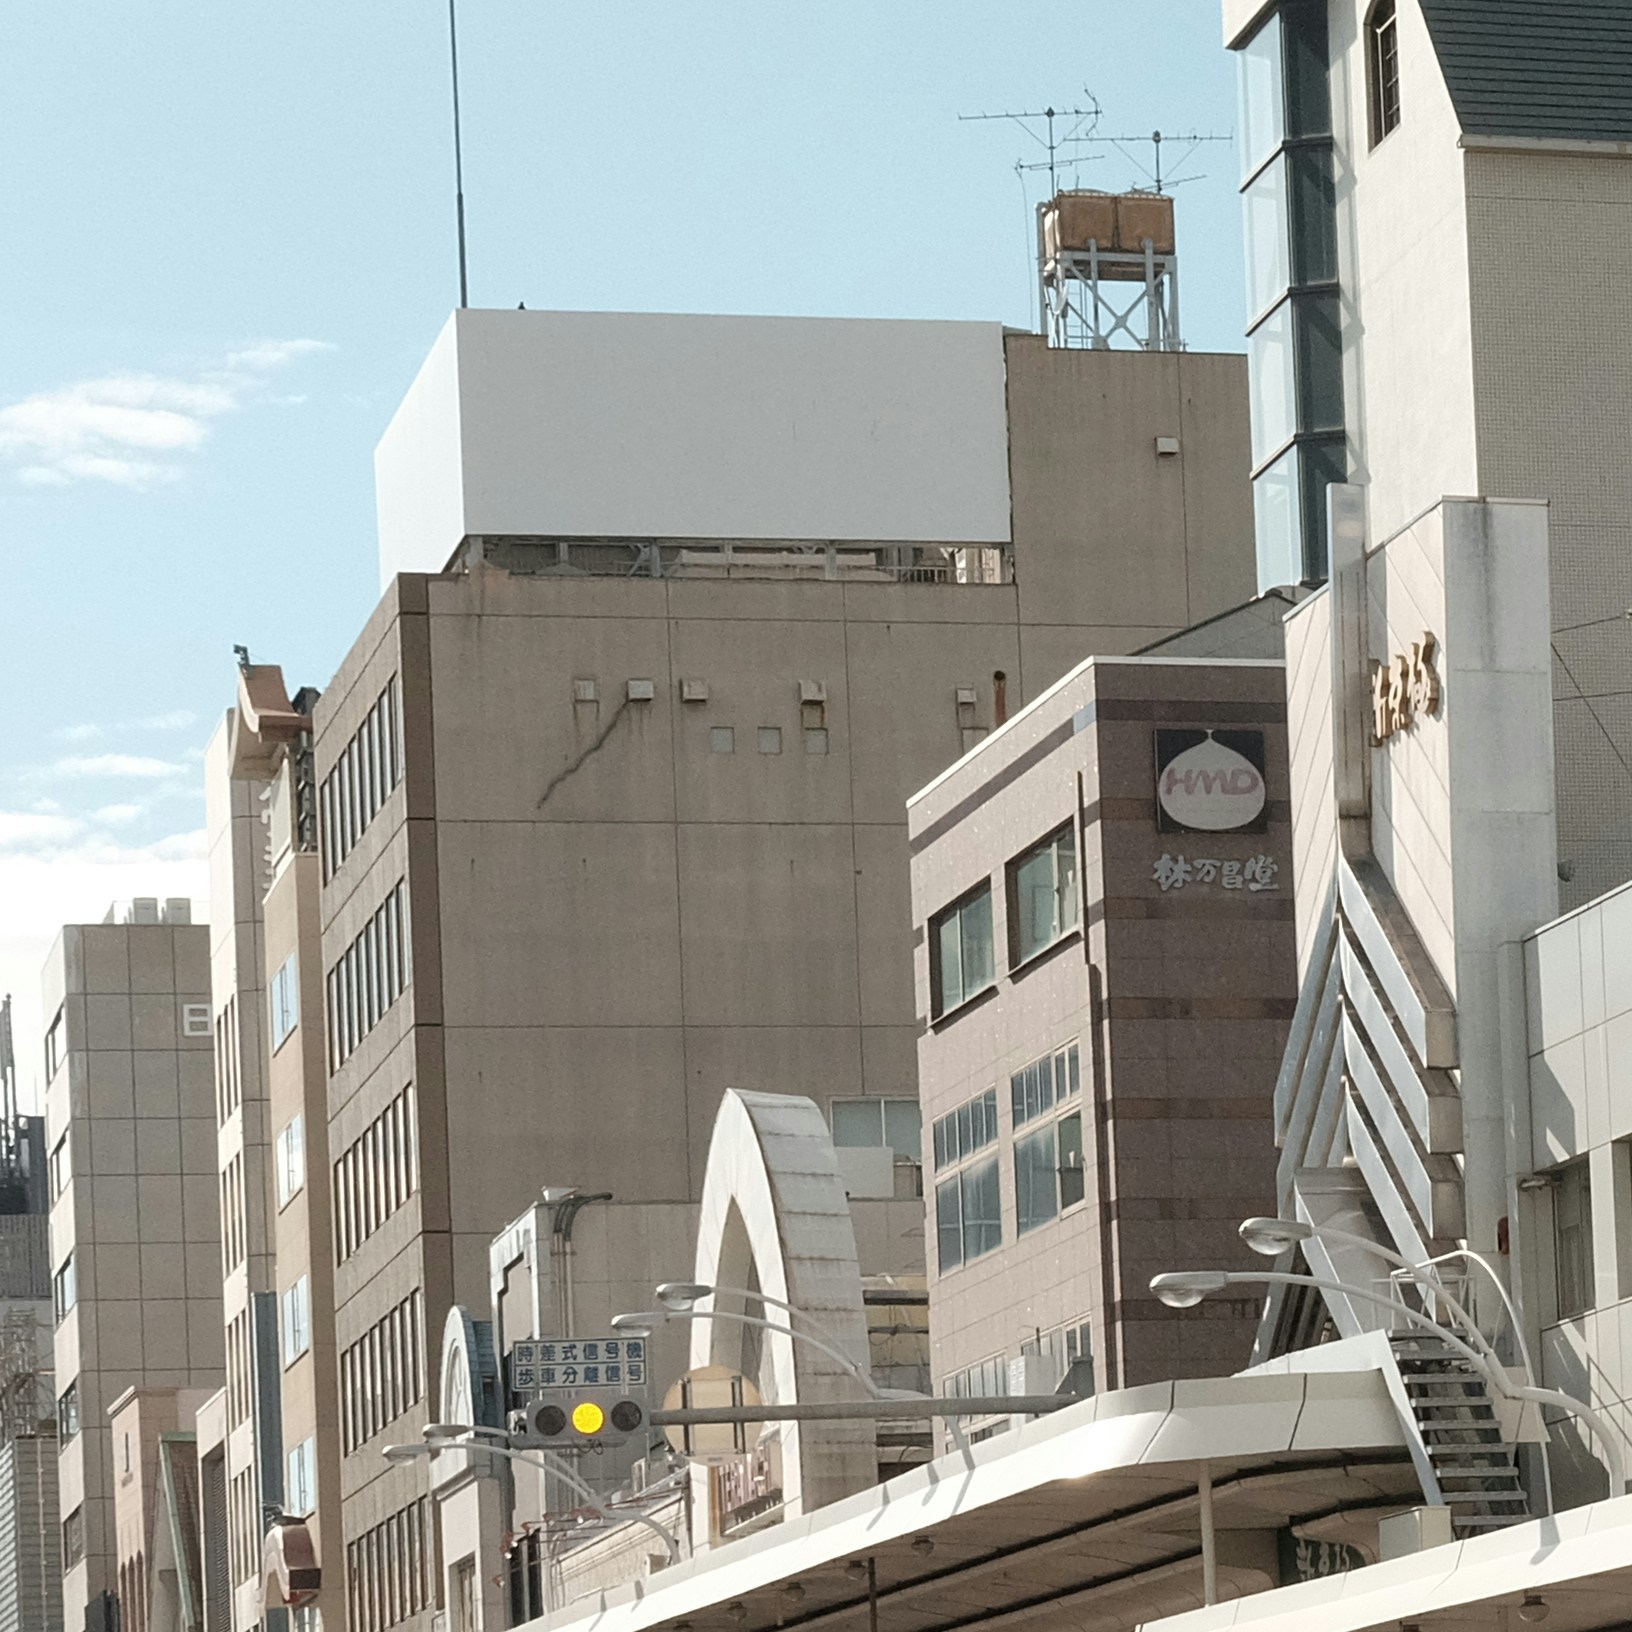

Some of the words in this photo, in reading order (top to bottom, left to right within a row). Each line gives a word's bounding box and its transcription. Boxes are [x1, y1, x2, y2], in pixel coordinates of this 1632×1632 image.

[1165, 767, 1260, 796] HMD
[1152, 853, 1280, 892] 林万昌堂
[517, 1341, 643, 1363] 時差式信号機
[517, 1363, 644, 1386] 歩車分離信号
